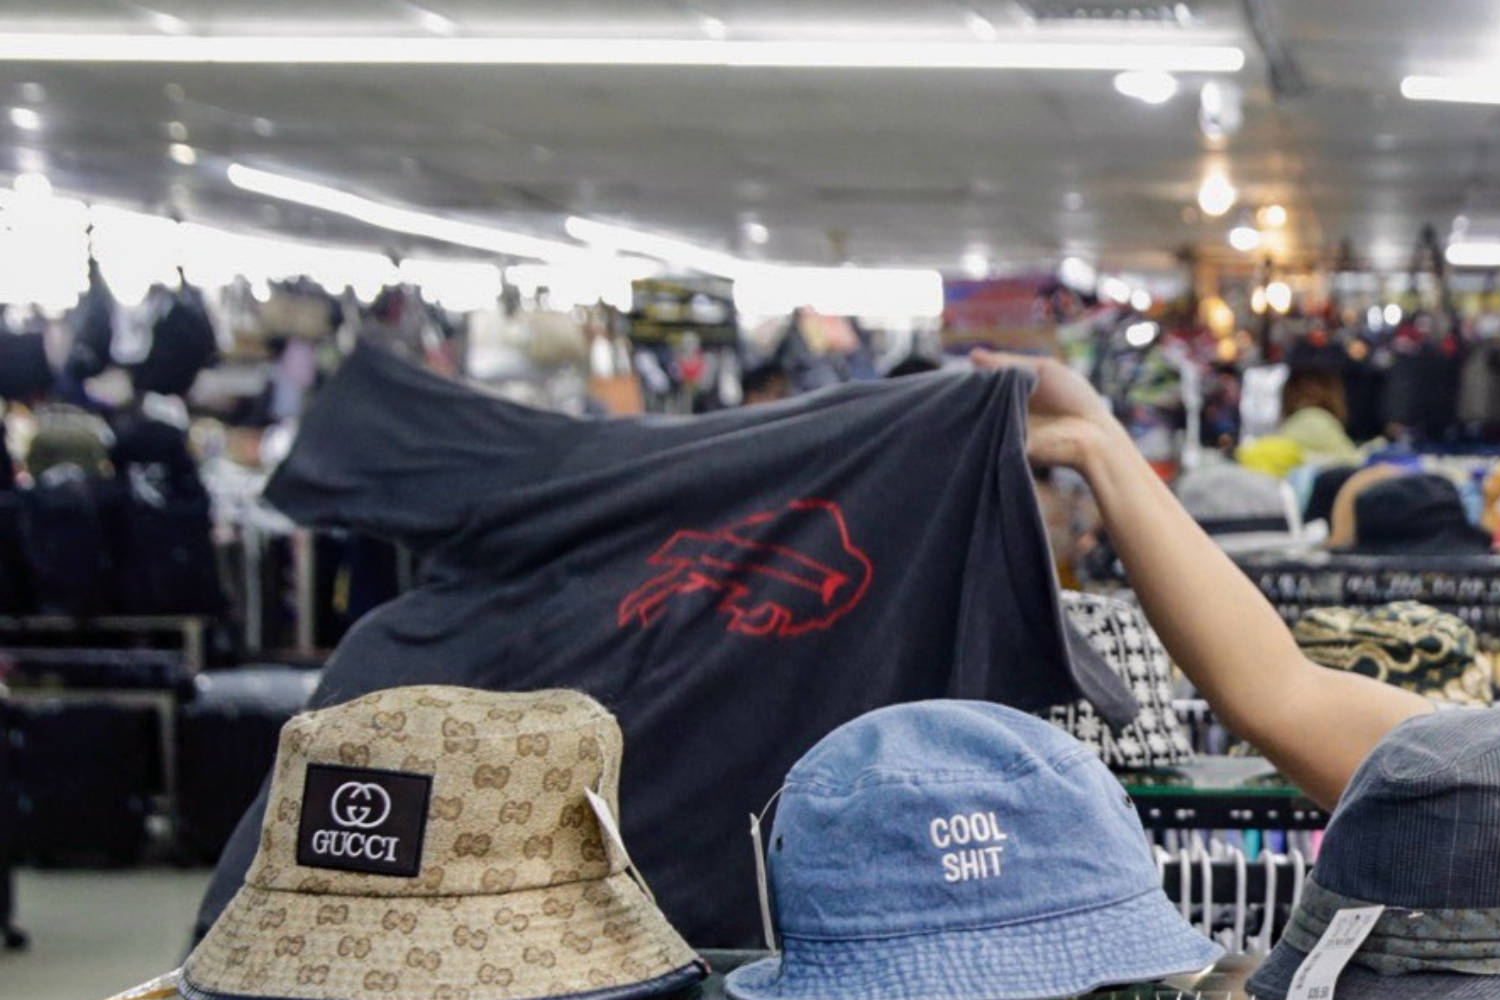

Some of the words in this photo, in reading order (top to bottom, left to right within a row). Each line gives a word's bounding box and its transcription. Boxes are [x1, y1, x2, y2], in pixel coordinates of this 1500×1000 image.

[312, 829, 400, 862] GUCCI
[930, 811, 1008, 849] COOL
[941, 846, 1004, 882] SHIT
